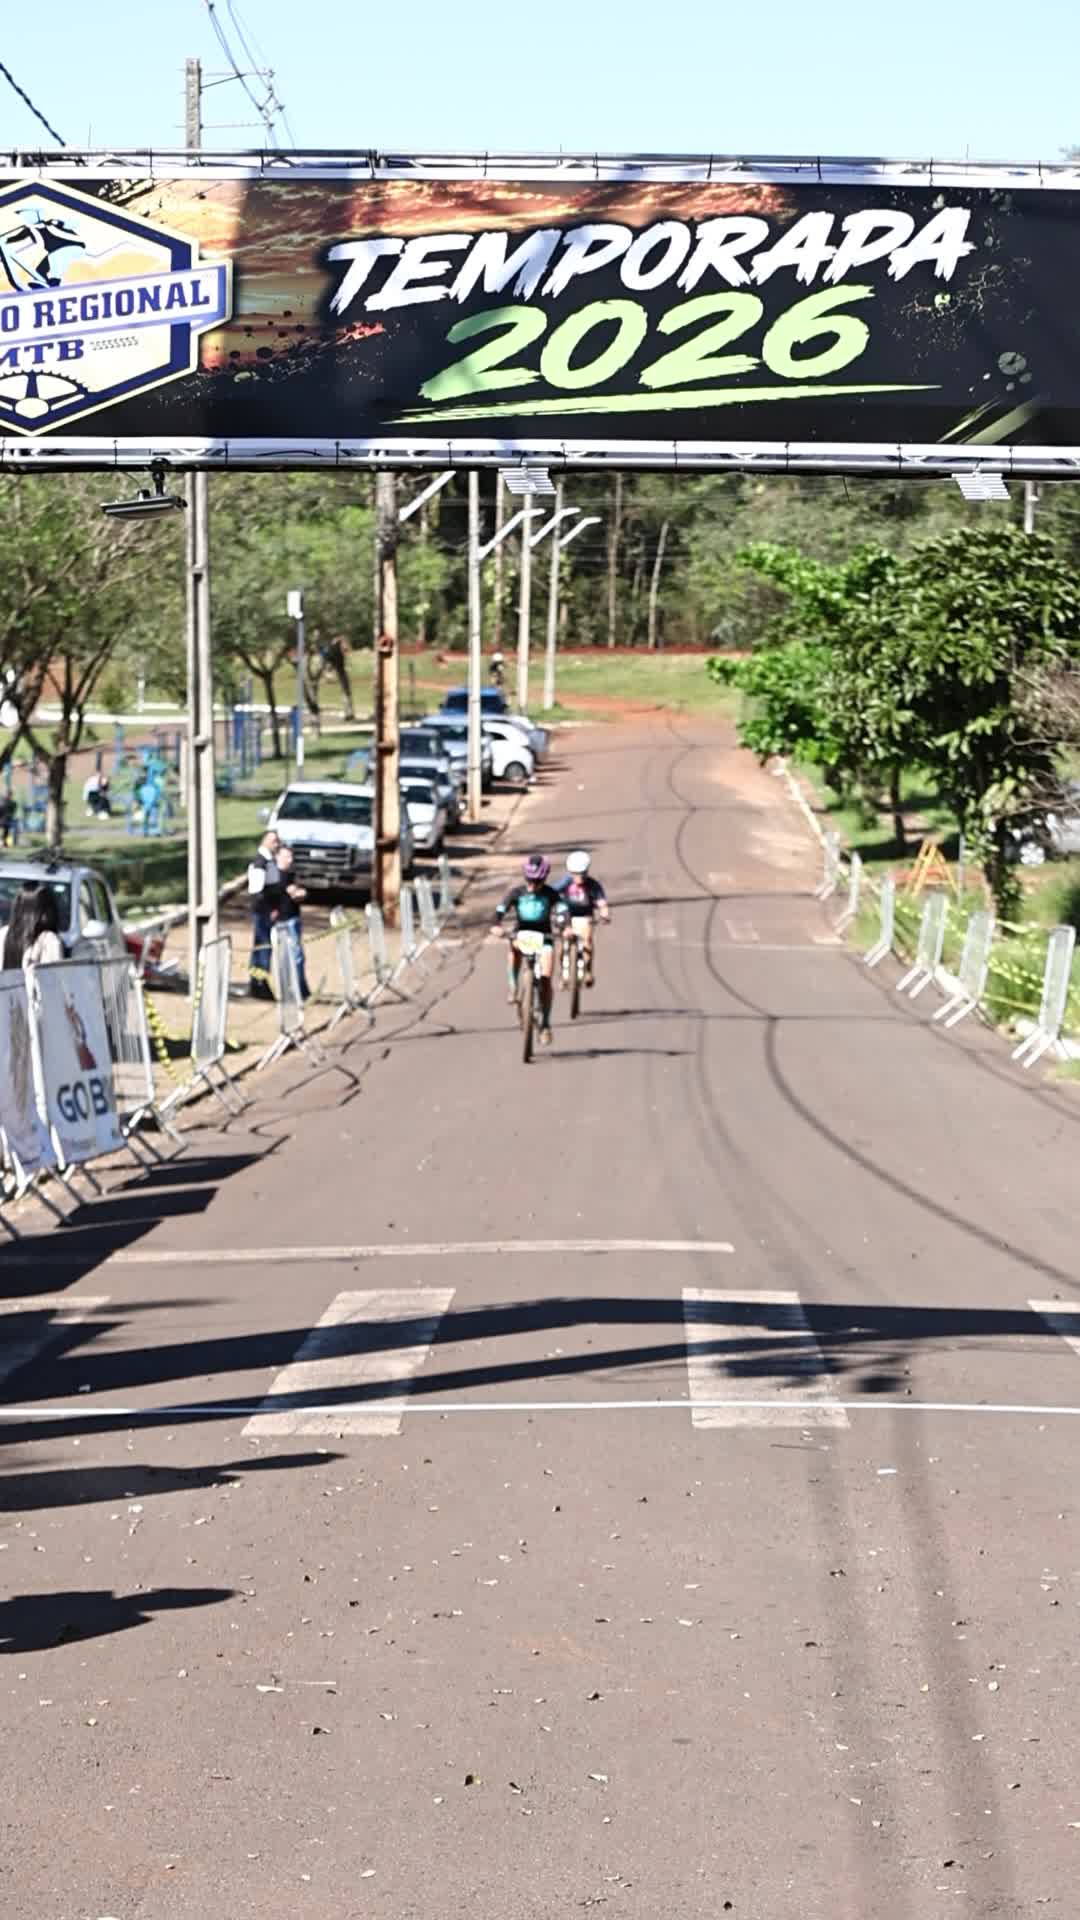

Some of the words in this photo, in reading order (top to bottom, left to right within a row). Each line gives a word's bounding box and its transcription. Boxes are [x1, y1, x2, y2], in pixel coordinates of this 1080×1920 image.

[33, 279, 210, 328] REGIONAL
[328, 207, 977, 316] TEMPORADA
[418, 284, 876, 401] 2026
